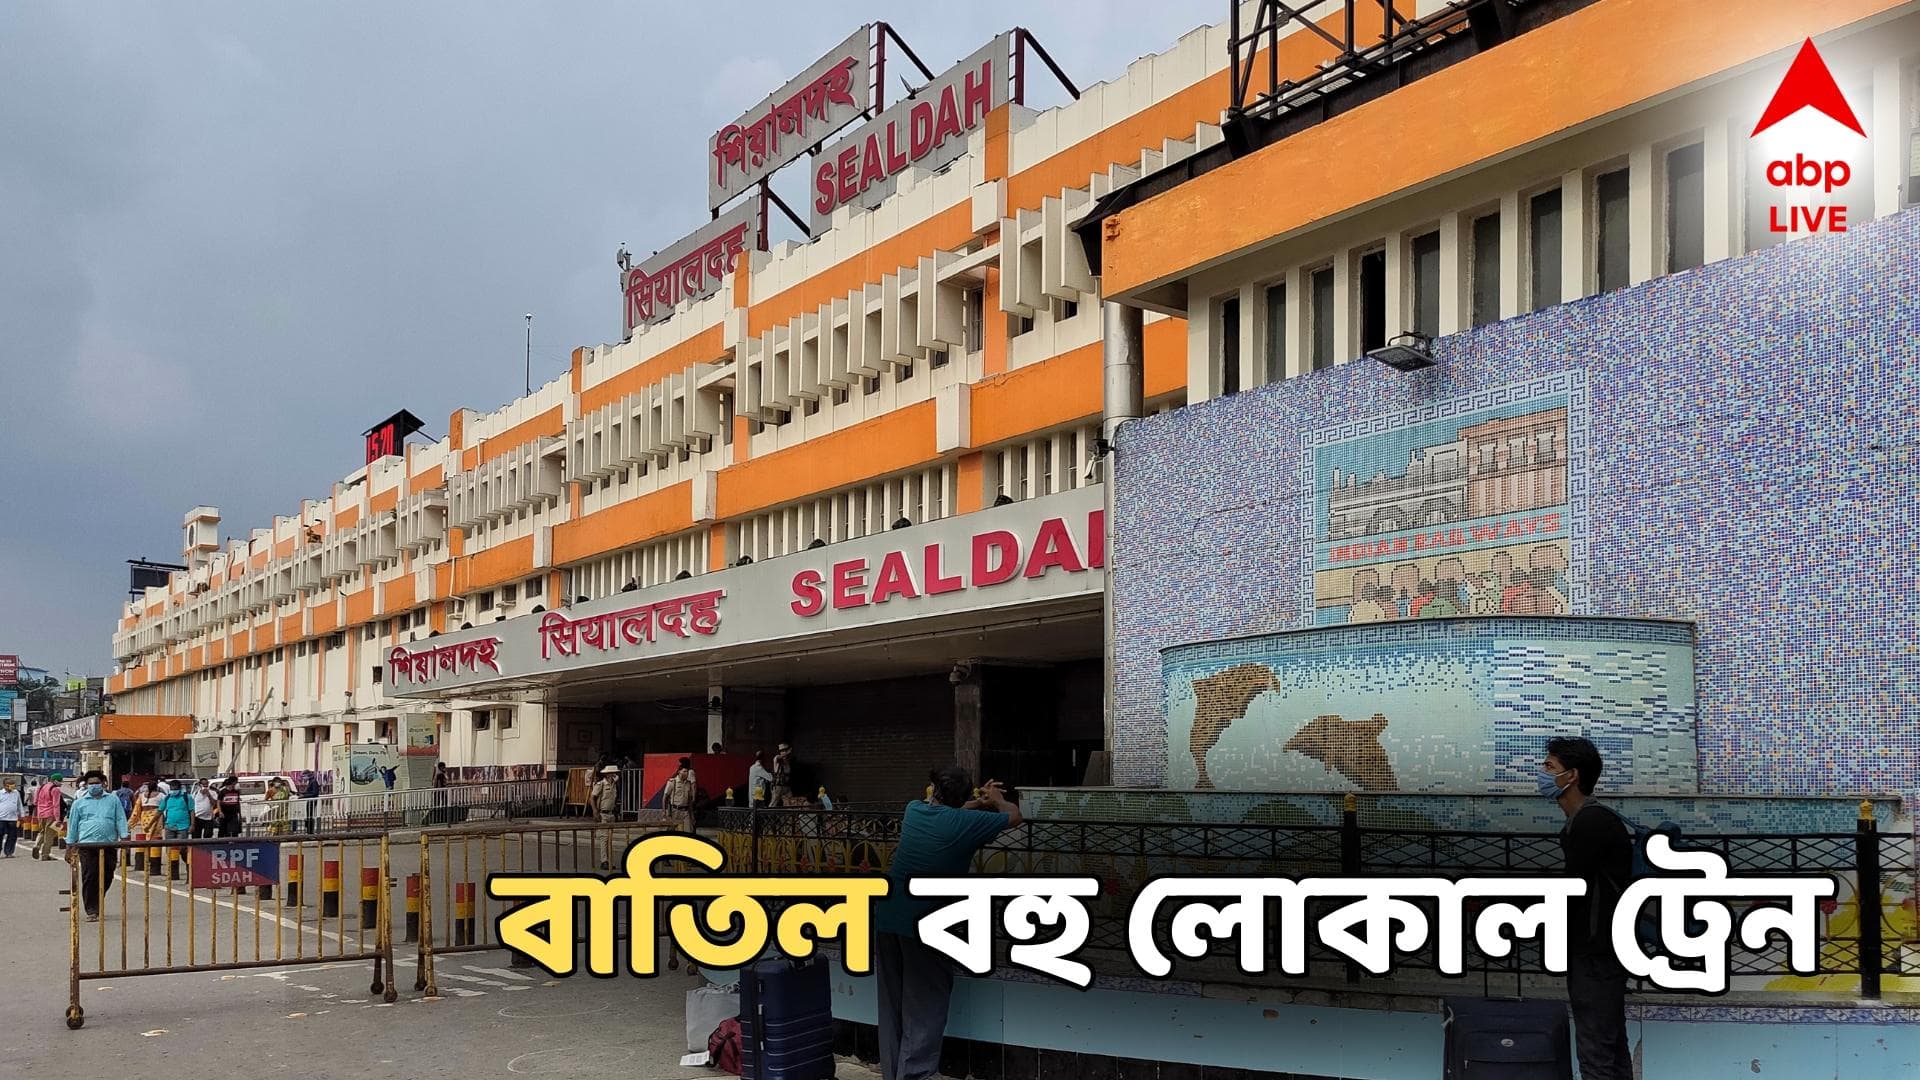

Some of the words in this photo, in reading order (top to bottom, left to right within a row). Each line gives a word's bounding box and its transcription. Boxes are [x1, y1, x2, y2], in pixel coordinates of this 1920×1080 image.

[712, 56, 860, 188] শিয়ালদহ
[815, 59, 992, 216] SEALDAH
[1328, 536, 1408, 563] INDIAN
[538, 588, 727, 660] सियालदह
[388, 636, 503, 687] শিয়ালদহ
[211, 848, 260, 869] RPF
[211, 871, 253, 884] SDAH
